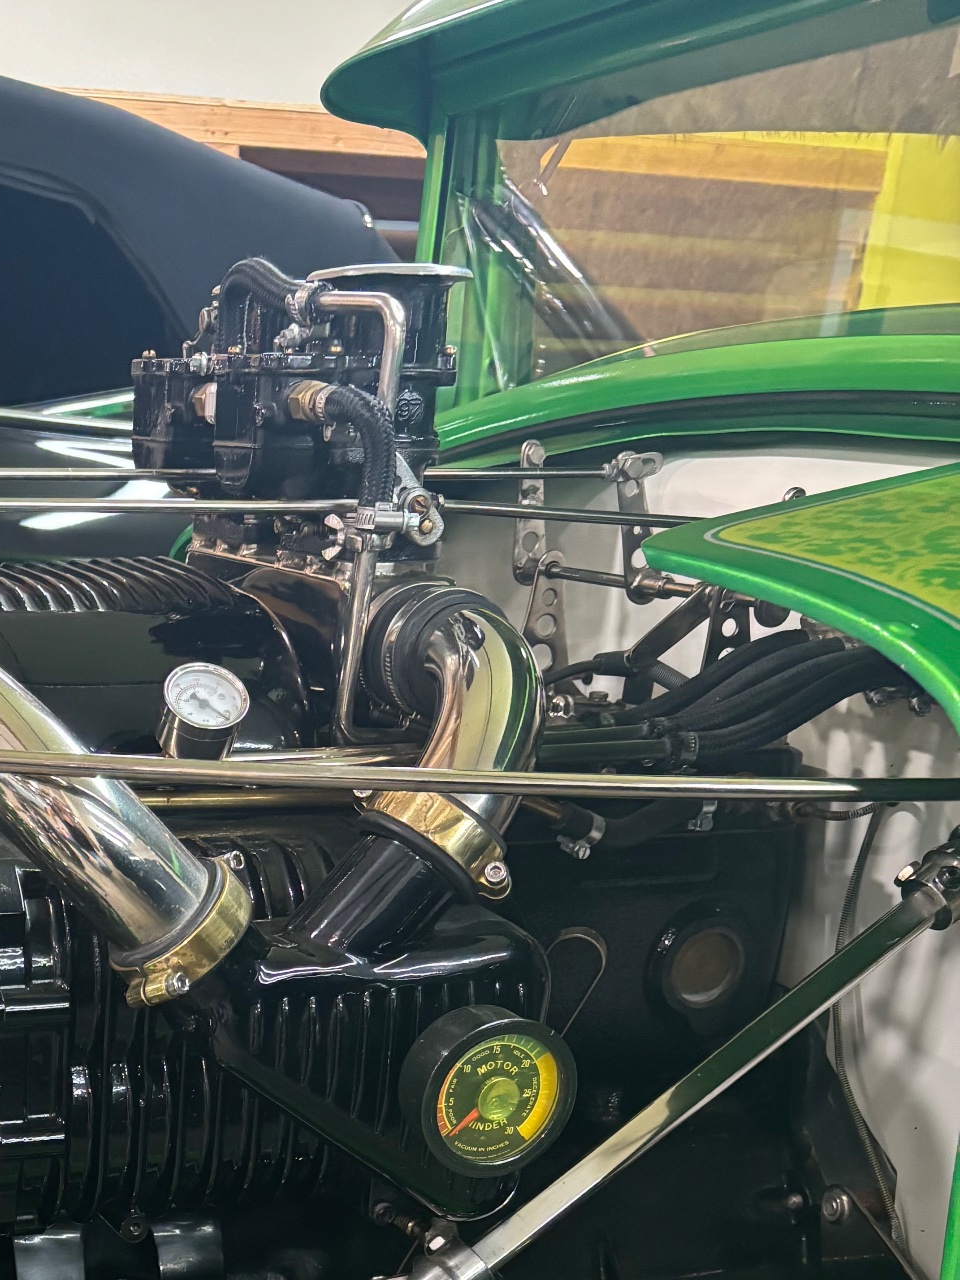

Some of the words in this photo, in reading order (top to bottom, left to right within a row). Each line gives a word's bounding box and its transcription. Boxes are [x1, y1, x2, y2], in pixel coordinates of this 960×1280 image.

[398, 400, 421, 421] 97
[493, 1046, 501, 1054] 15
[477, 1060, 518, 1075] MOTOR
[521, 1059, 530, 1067] 20
[463, 1064, 471, 1073] 10
[449, 1078, 457, 1092] FAIR
[522, 1089, 532, 1097] 25
[448, 1097, 454, 1105] 5
[504, 1126, 514, 1135] 30
[454, 1140, 477, 1152] VACUUM
[486, 1140, 510, 1152] INCHES
